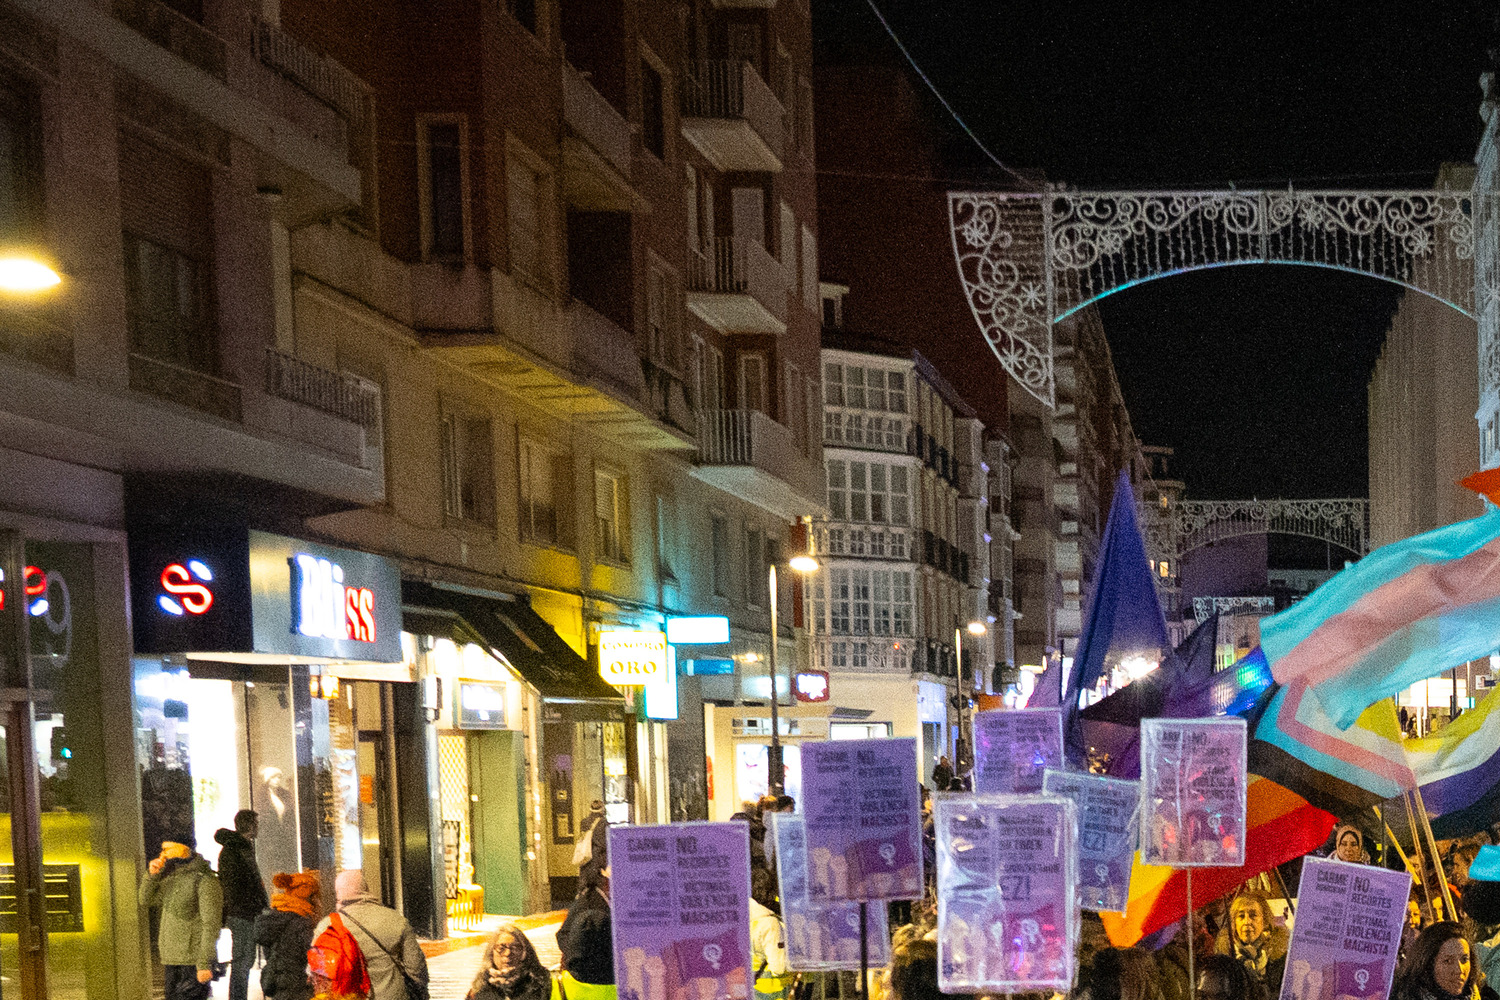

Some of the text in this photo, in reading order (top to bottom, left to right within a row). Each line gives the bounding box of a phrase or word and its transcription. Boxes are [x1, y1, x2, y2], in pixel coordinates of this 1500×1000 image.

[610, 661, 657, 675] ORO
[676, 836, 698, 854] NO
[1353, 876, 1370, 893] NO
[1346, 925, 1392, 942] VIOLENCIA
[1343, 939, 1389, 956] MACHISTA
